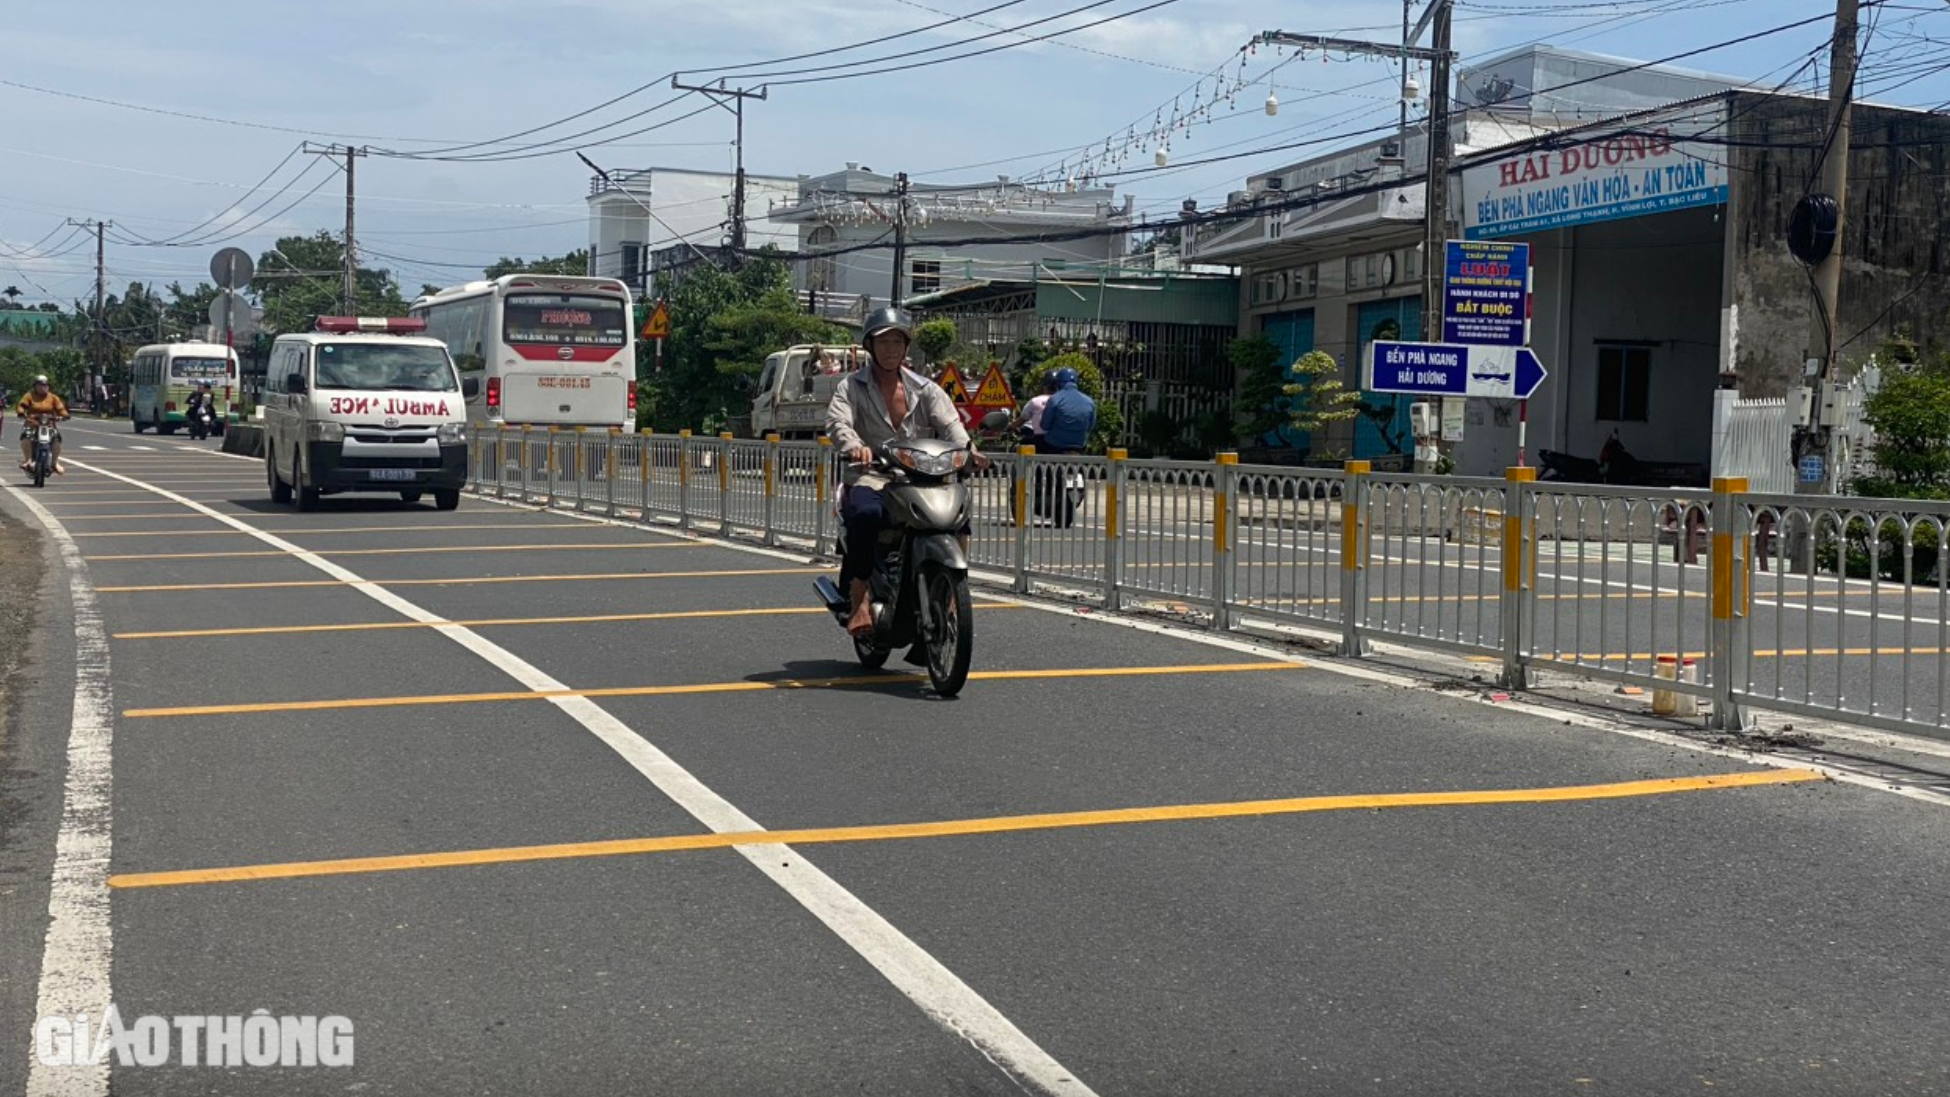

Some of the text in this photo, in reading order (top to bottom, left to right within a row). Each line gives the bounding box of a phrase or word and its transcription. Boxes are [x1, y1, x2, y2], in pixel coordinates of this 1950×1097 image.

[1478, 190, 1499, 224] BẾN
[1502, 189, 1524, 219] PHÀ
[1528, 186, 1569, 215] NGANG
[1573, 176, 1598, 206] VĂN
[1604, 170, 1630, 202] HÓA
[1642, 168, 1662, 196] AN
[1666, 155, 1706, 192] TOÀN
[1460, 262, 1511, 278] LUẬT
[1473, 290, 1498, 298] KHÁCH
[1482, 302, 1512, 316] BUỘC
[1386, 346, 1457, 366] BẾN PHÀ NGANG
[1398, 367, 1447, 385] HẢI DƯƠNG
